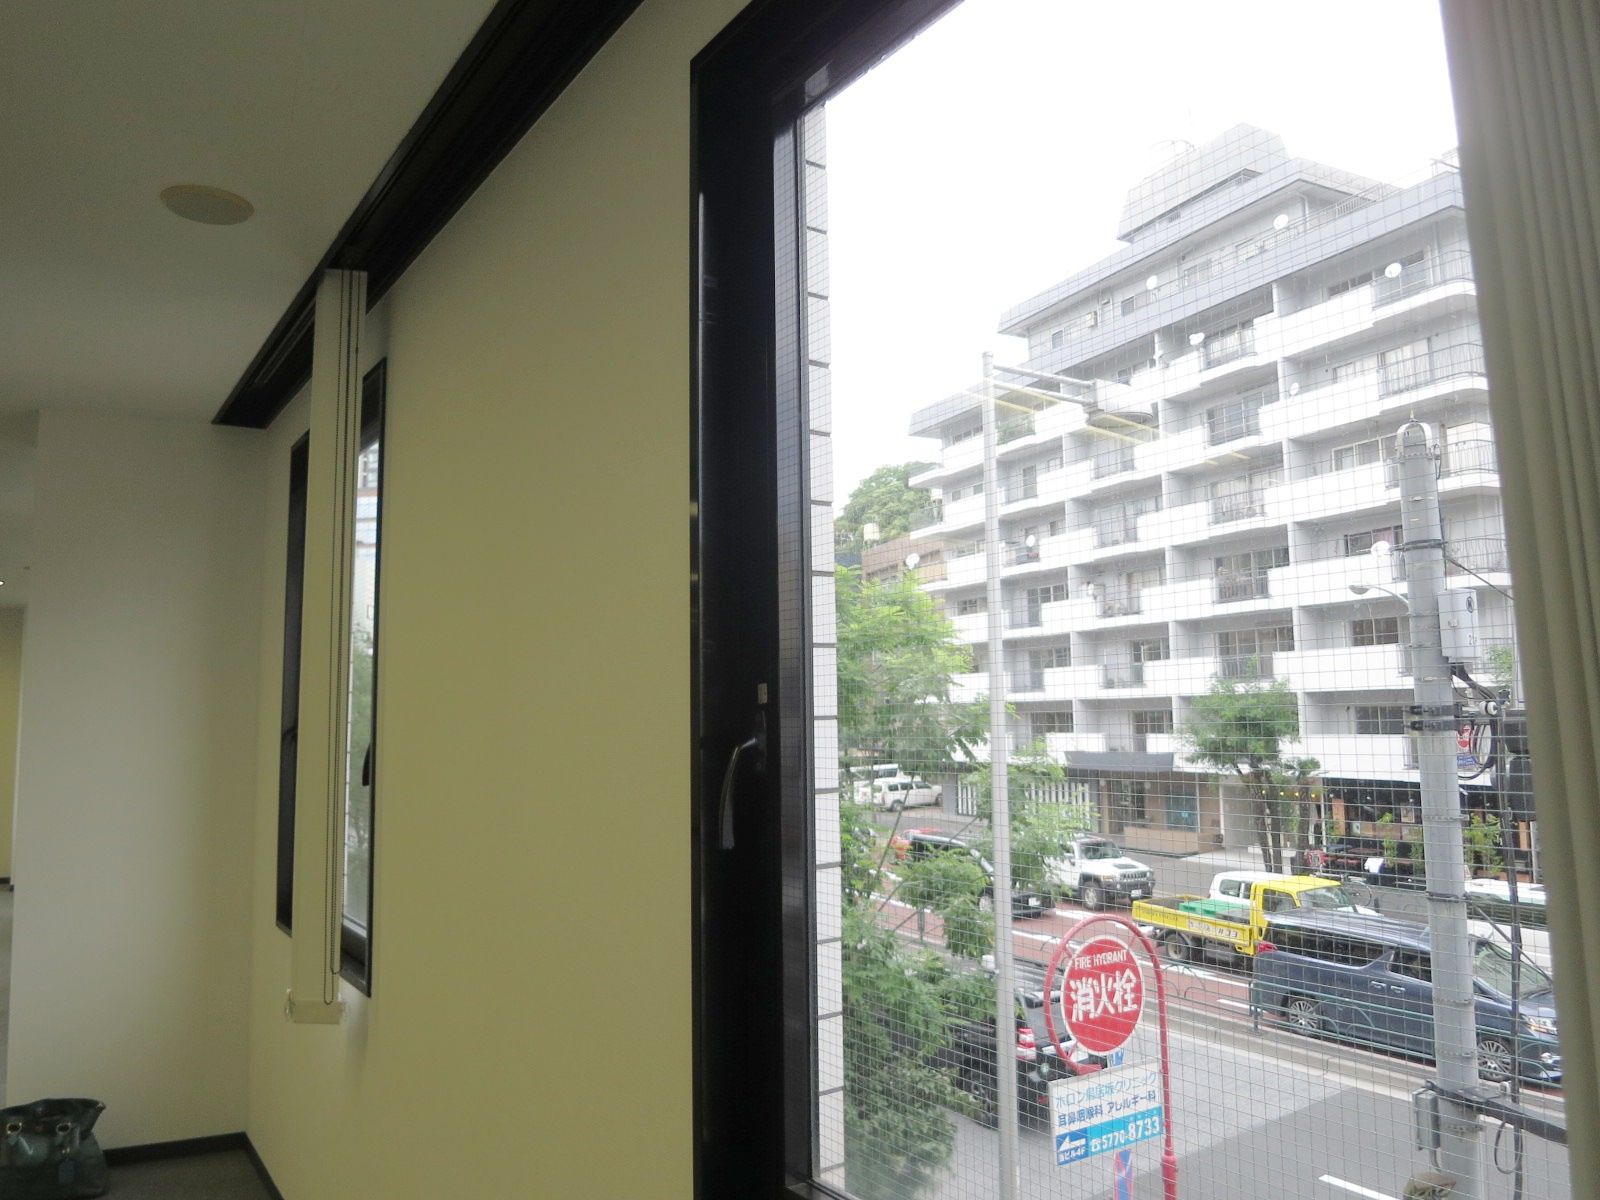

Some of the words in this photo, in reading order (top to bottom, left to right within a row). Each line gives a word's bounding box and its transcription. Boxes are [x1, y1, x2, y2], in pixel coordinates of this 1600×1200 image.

[1075, 956, 1091, 970] FIRE
[1093, 950, 1127, 967] HYDRANT
[1069, 968, 1138, 1023] 消火栓
[1058, 1104, 1103, 1127] 耳鼻咽喉科
[1107, 1090, 1156, 1113] アレルギー科
